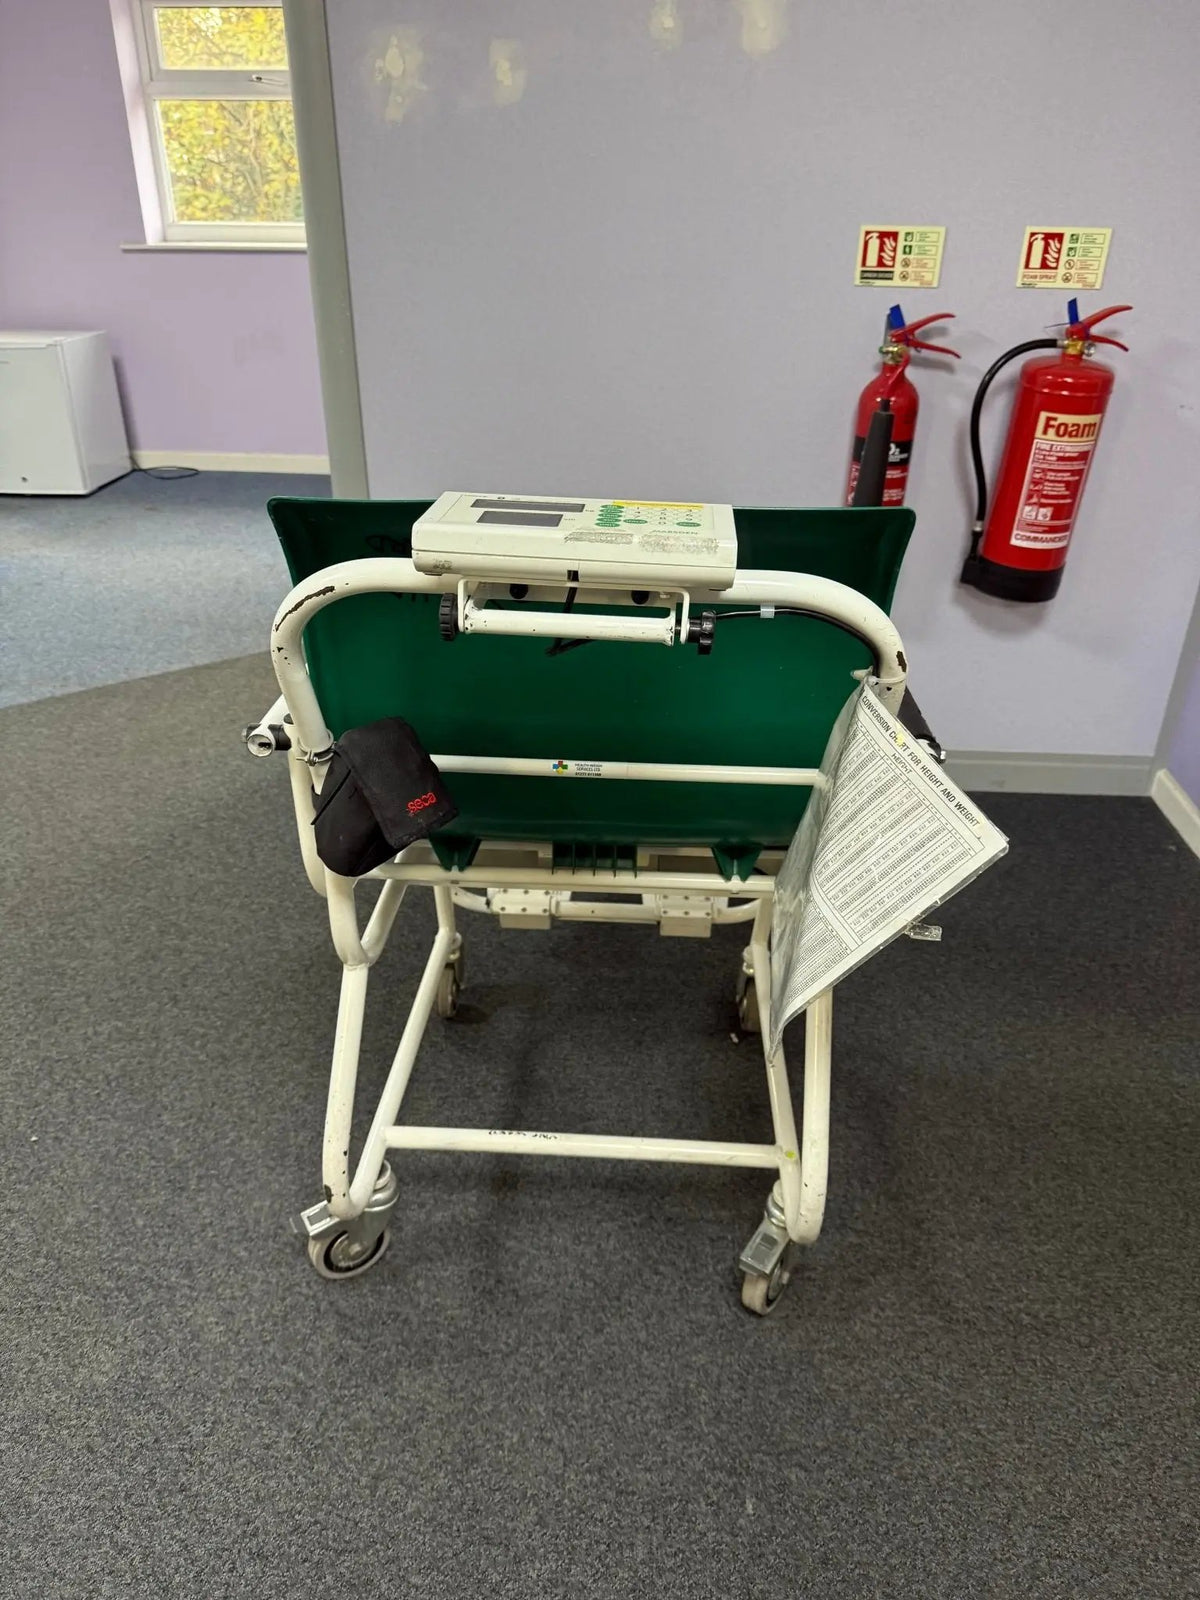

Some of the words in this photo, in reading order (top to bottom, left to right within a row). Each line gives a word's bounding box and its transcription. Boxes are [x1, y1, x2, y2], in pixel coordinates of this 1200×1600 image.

[1042, 416, 1097, 438] Foam
[861, 696, 892, 733] CONVERSION
[907, 751, 922, 766] FOR
[920, 764, 944, 788] HEIGHT
[940, 787, 956, 803] AND
[954, 801, 980, 827] WEIGHT
[891, 753, 913, 774] HEIGHT
[408, 792, 437, 812] seca
